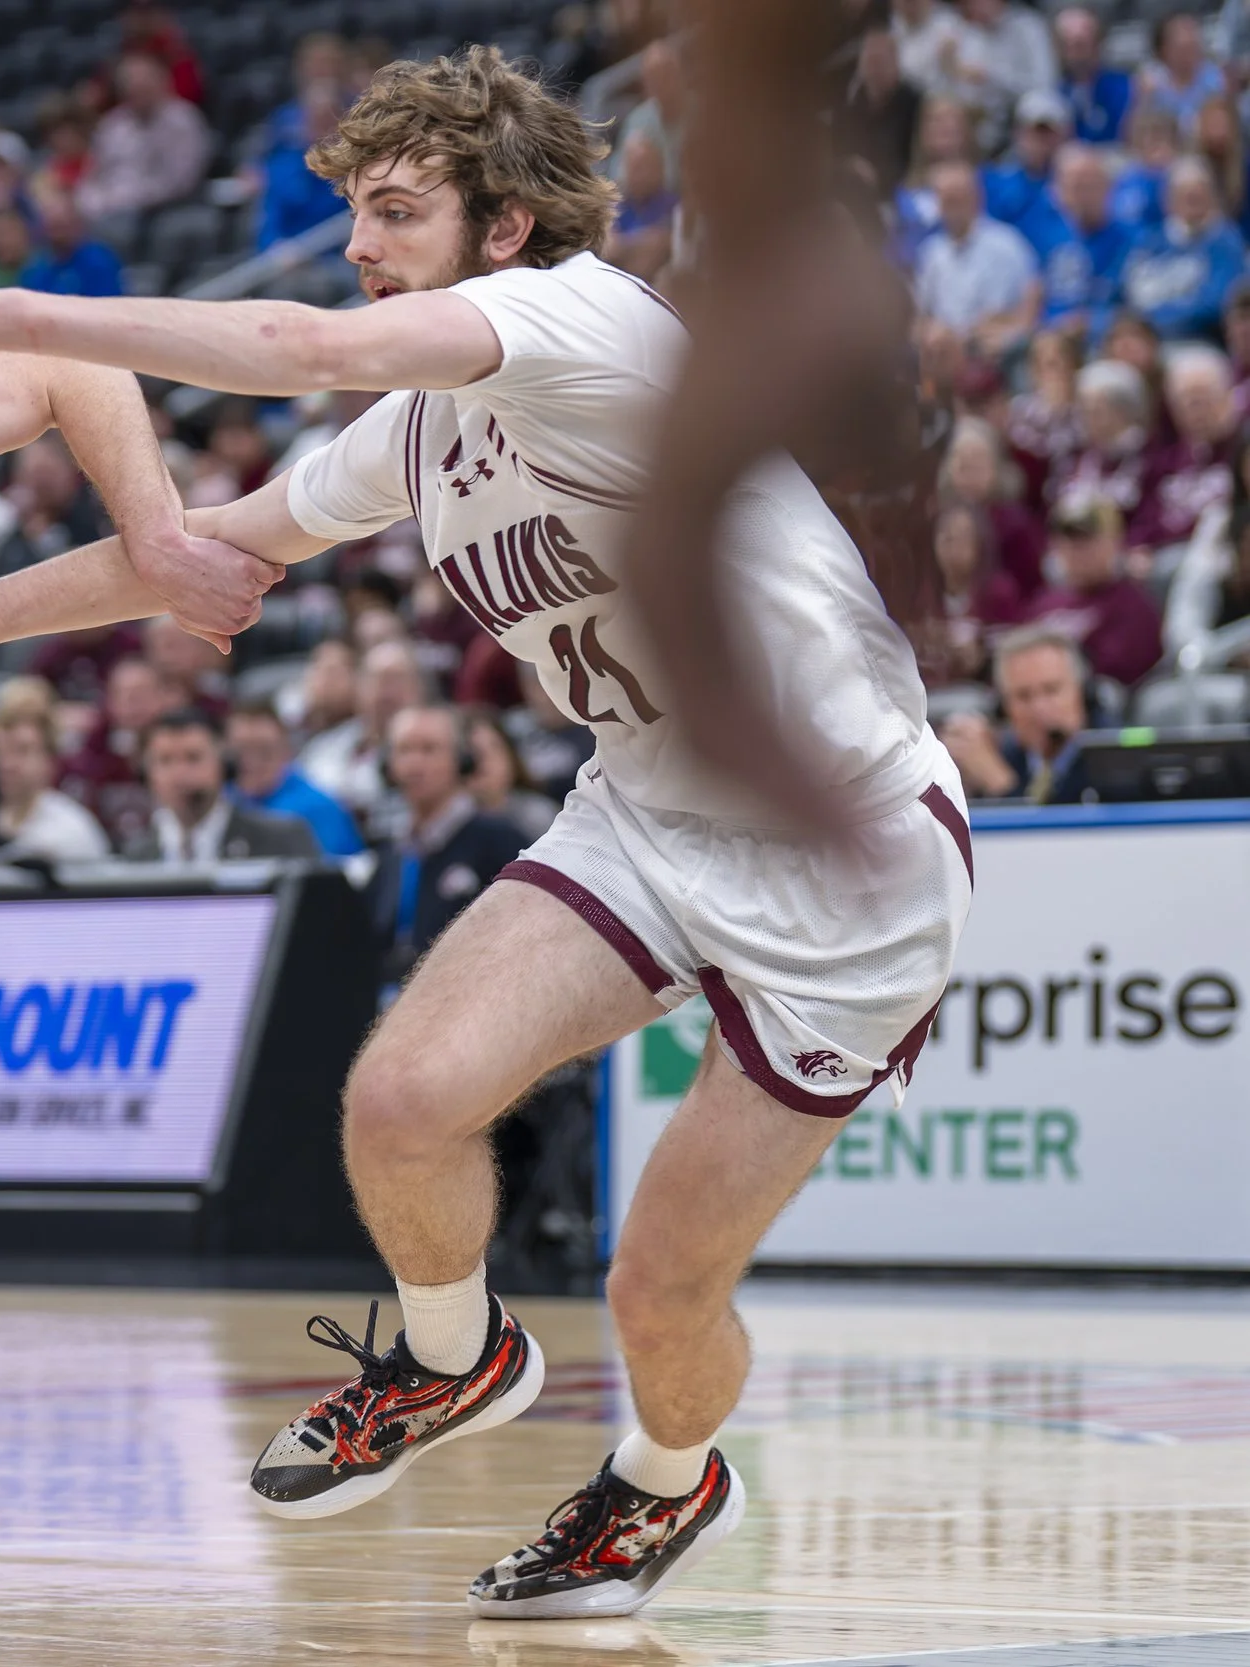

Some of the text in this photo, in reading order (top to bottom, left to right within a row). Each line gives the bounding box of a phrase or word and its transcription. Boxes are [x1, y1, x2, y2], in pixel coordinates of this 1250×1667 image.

[433, 514, 618, 636] ALUKIS
[928, 946, 1238, 1074] rprise
[812, 1109, 1081, 1181] ENTER
